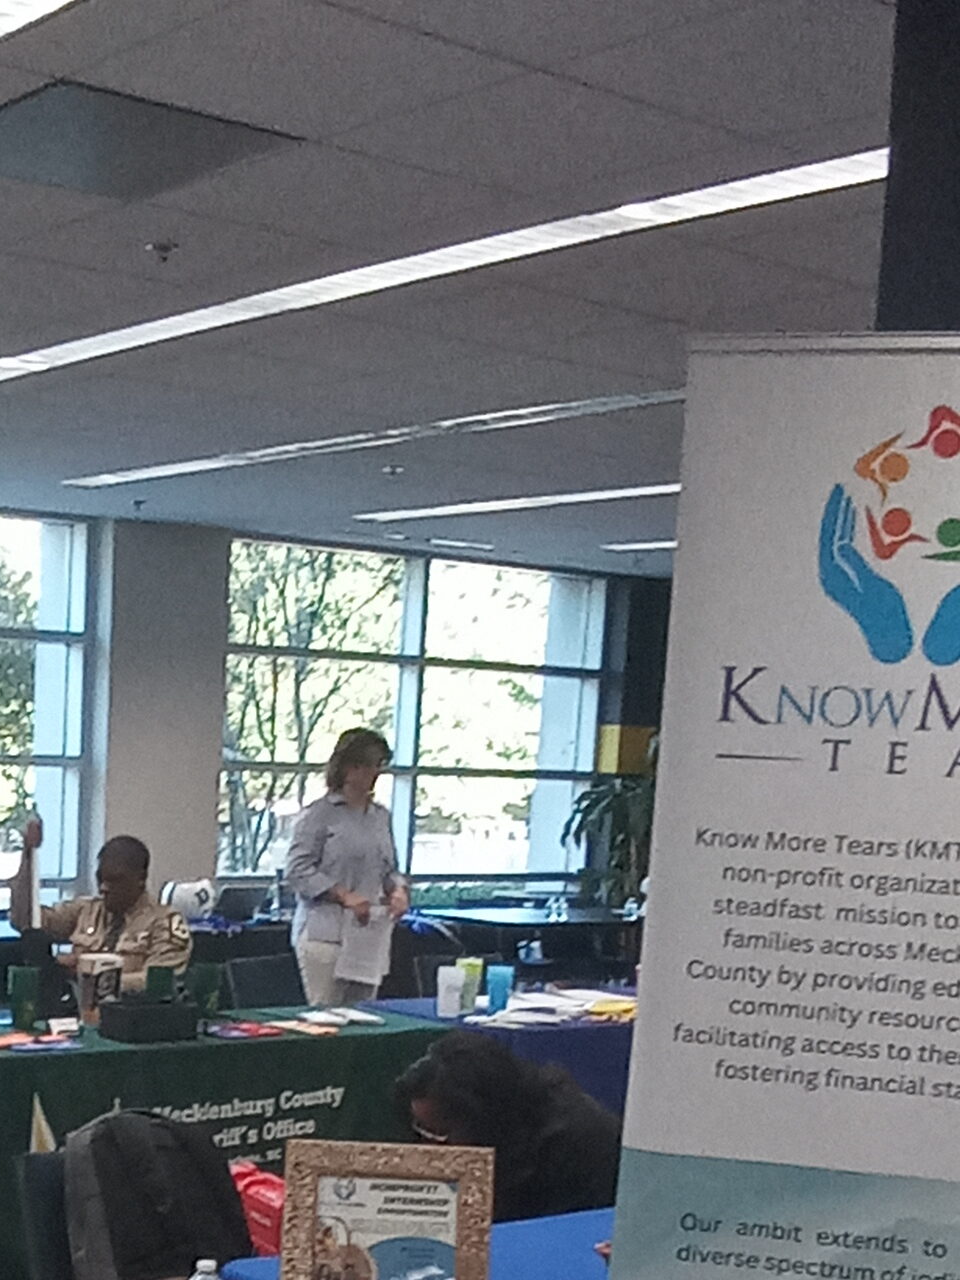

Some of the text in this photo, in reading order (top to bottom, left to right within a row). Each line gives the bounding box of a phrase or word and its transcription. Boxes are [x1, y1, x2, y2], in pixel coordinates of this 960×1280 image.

[694, 827, 760, 849] Know
[764, 831, 827, 853] More
[834, 834, 899, 857] Tears
[722, 866, 844, 889] non-profit
[712, 897, 959, 930] steadfast mission to
[722, 928, 814, 953] families
[819, 938, 899, 961] across
[685, 959, 771, 988] County
[777, 964, 807, 991] by
[812, 971, 926, 1000] providing
[728, 998, 960, 1032] community resourc
[672, 1022, 960, 1065] facilitating access to the
[714, 1059, 819, 1091] fostering
[824, 1068, 926, 1096] financial
[151, 1085, 345, 1123] Mecklenburg County
[262, 1118, 315, 1141] Office
[679, 1213, 948, 1259] Our ambit extends to
[676, 1244, 760, 1269] diverse
